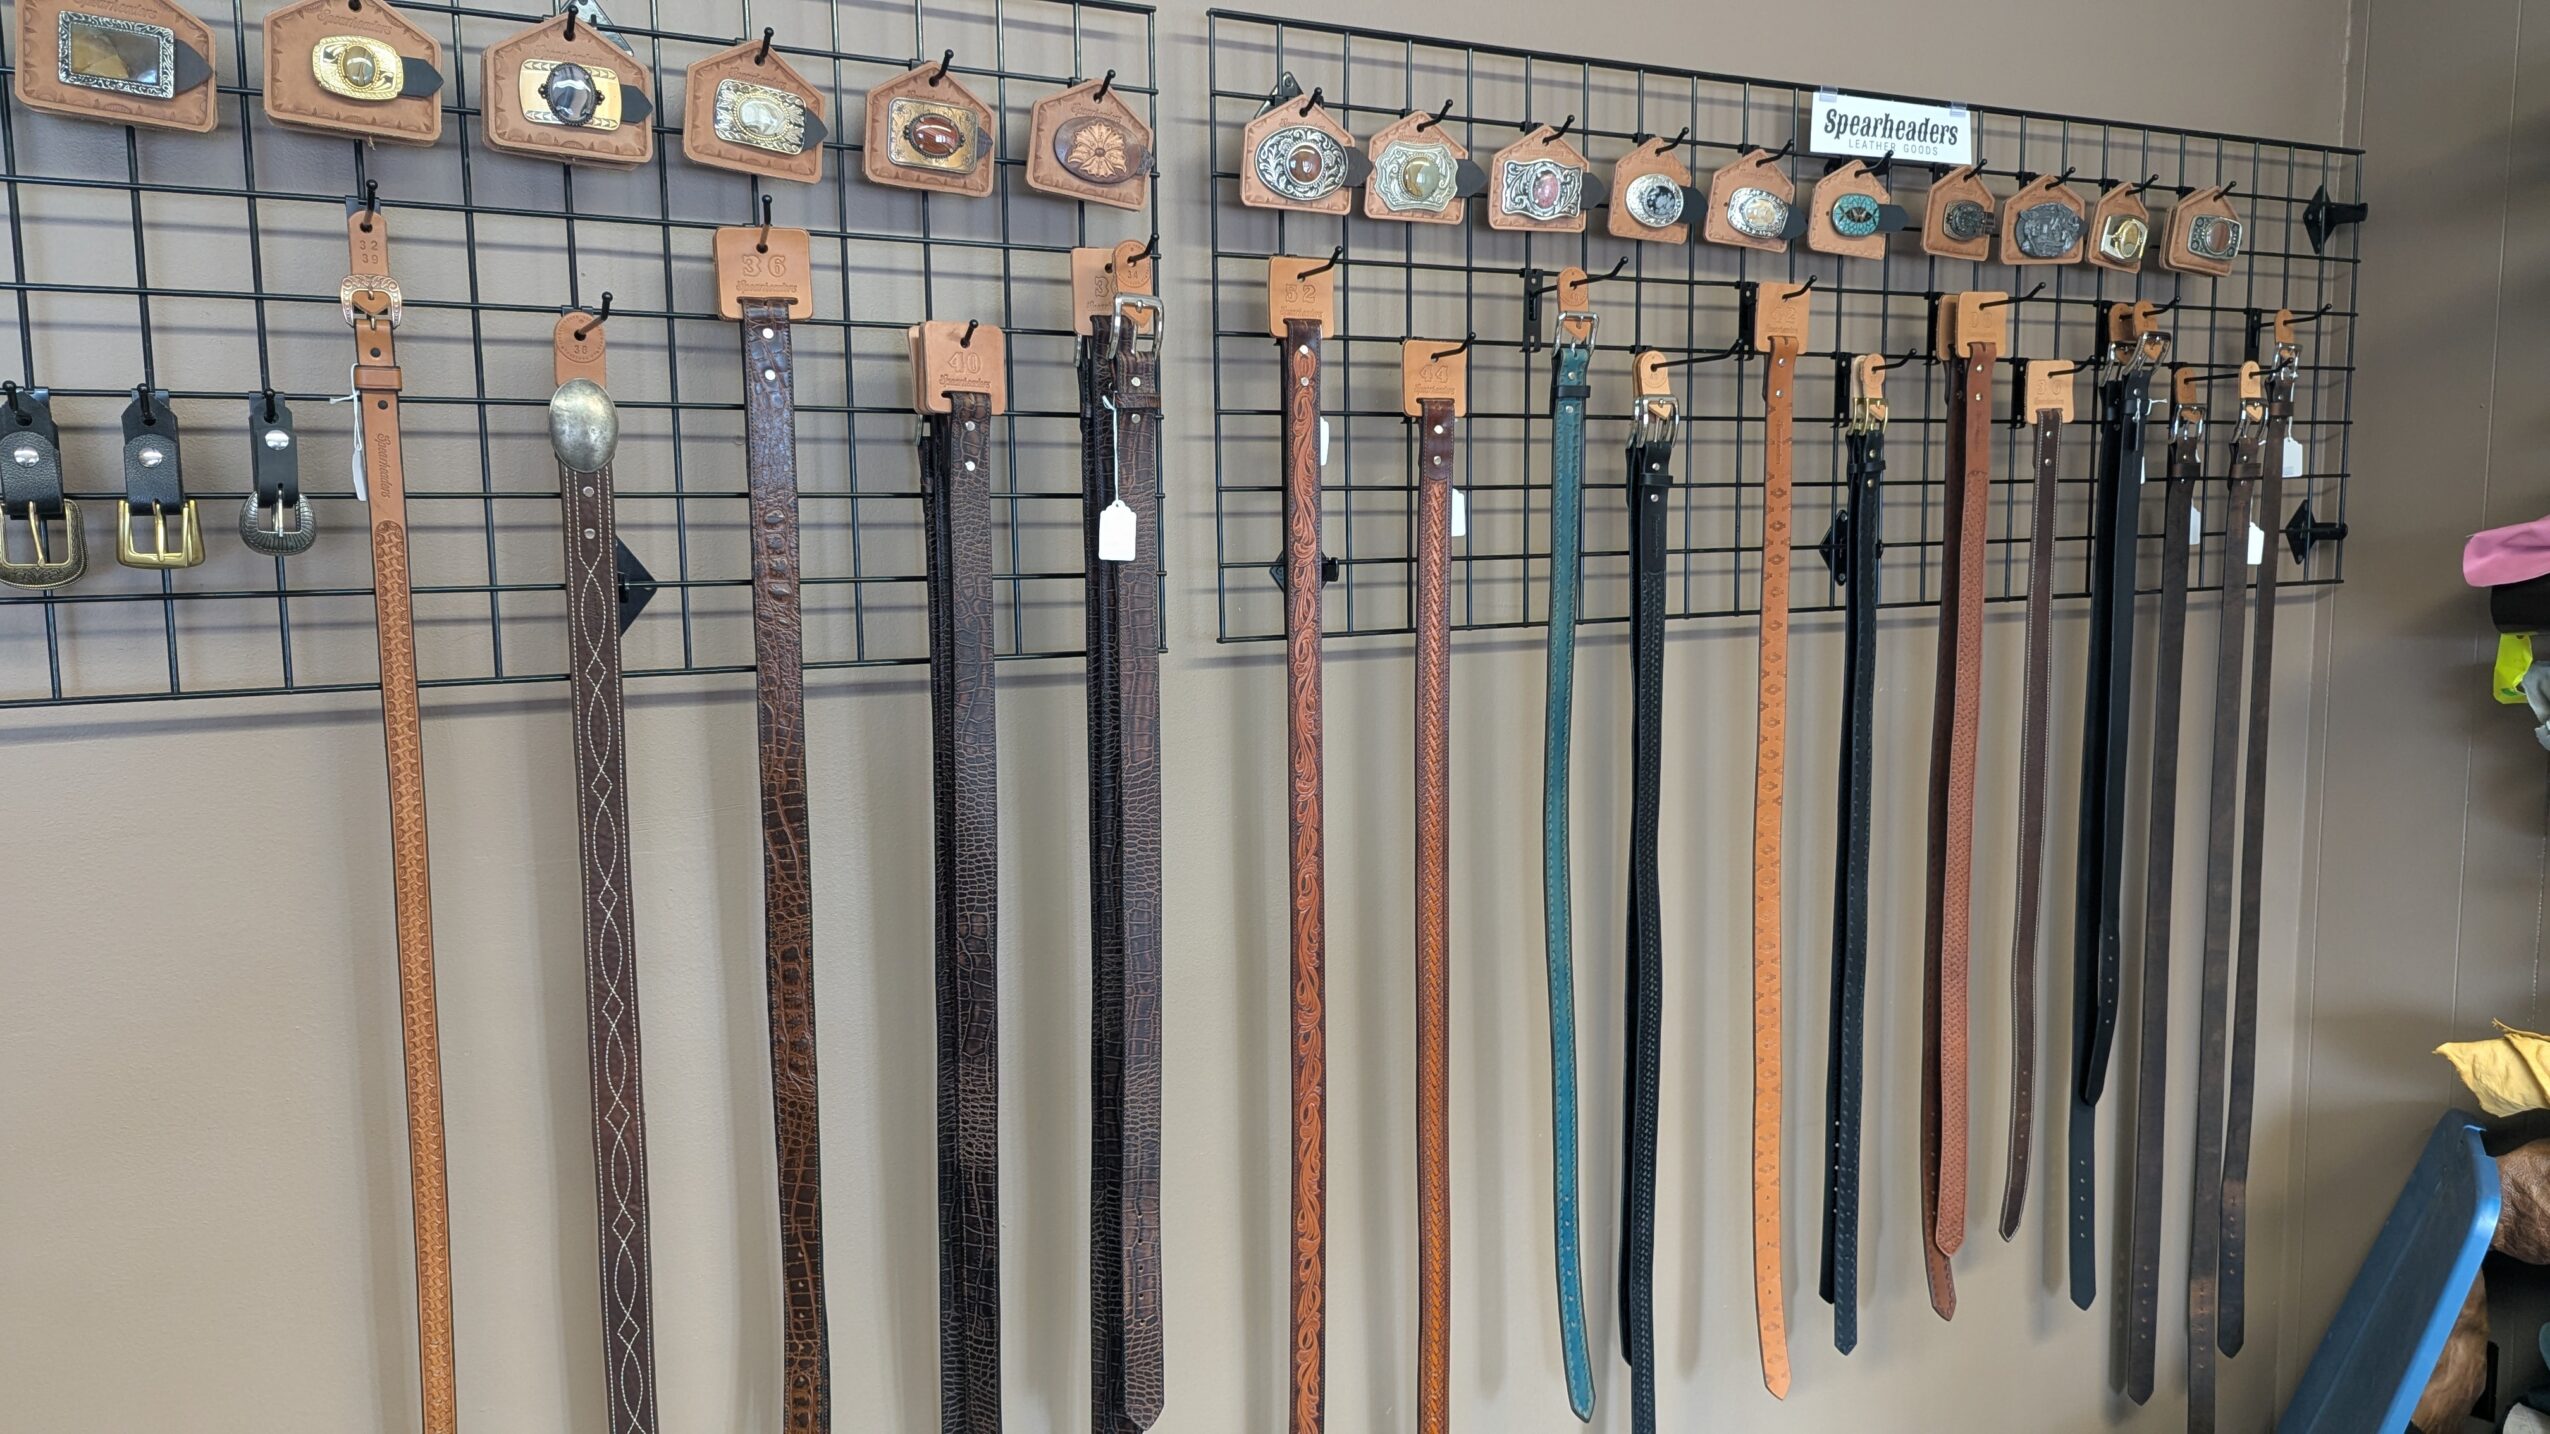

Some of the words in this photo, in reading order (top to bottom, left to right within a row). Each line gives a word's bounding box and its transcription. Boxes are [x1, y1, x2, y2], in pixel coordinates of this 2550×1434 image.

[1823, 108, 1959, 146] Spearheaders
[1848, 138, 1897, 151] LEATHER
[1903, 143, 1939, 156] GOODS
[359, 240, 379, 251] 32
[361, 253, 379, 265] 39
[741, 254, 787, 278] 36
[1285, 283, 1316, 304] 52
[947, 351, 982, 375] 40
[1419, 363, 1449, 384] 44
[374, 432, 393, 499] Spearheaders
